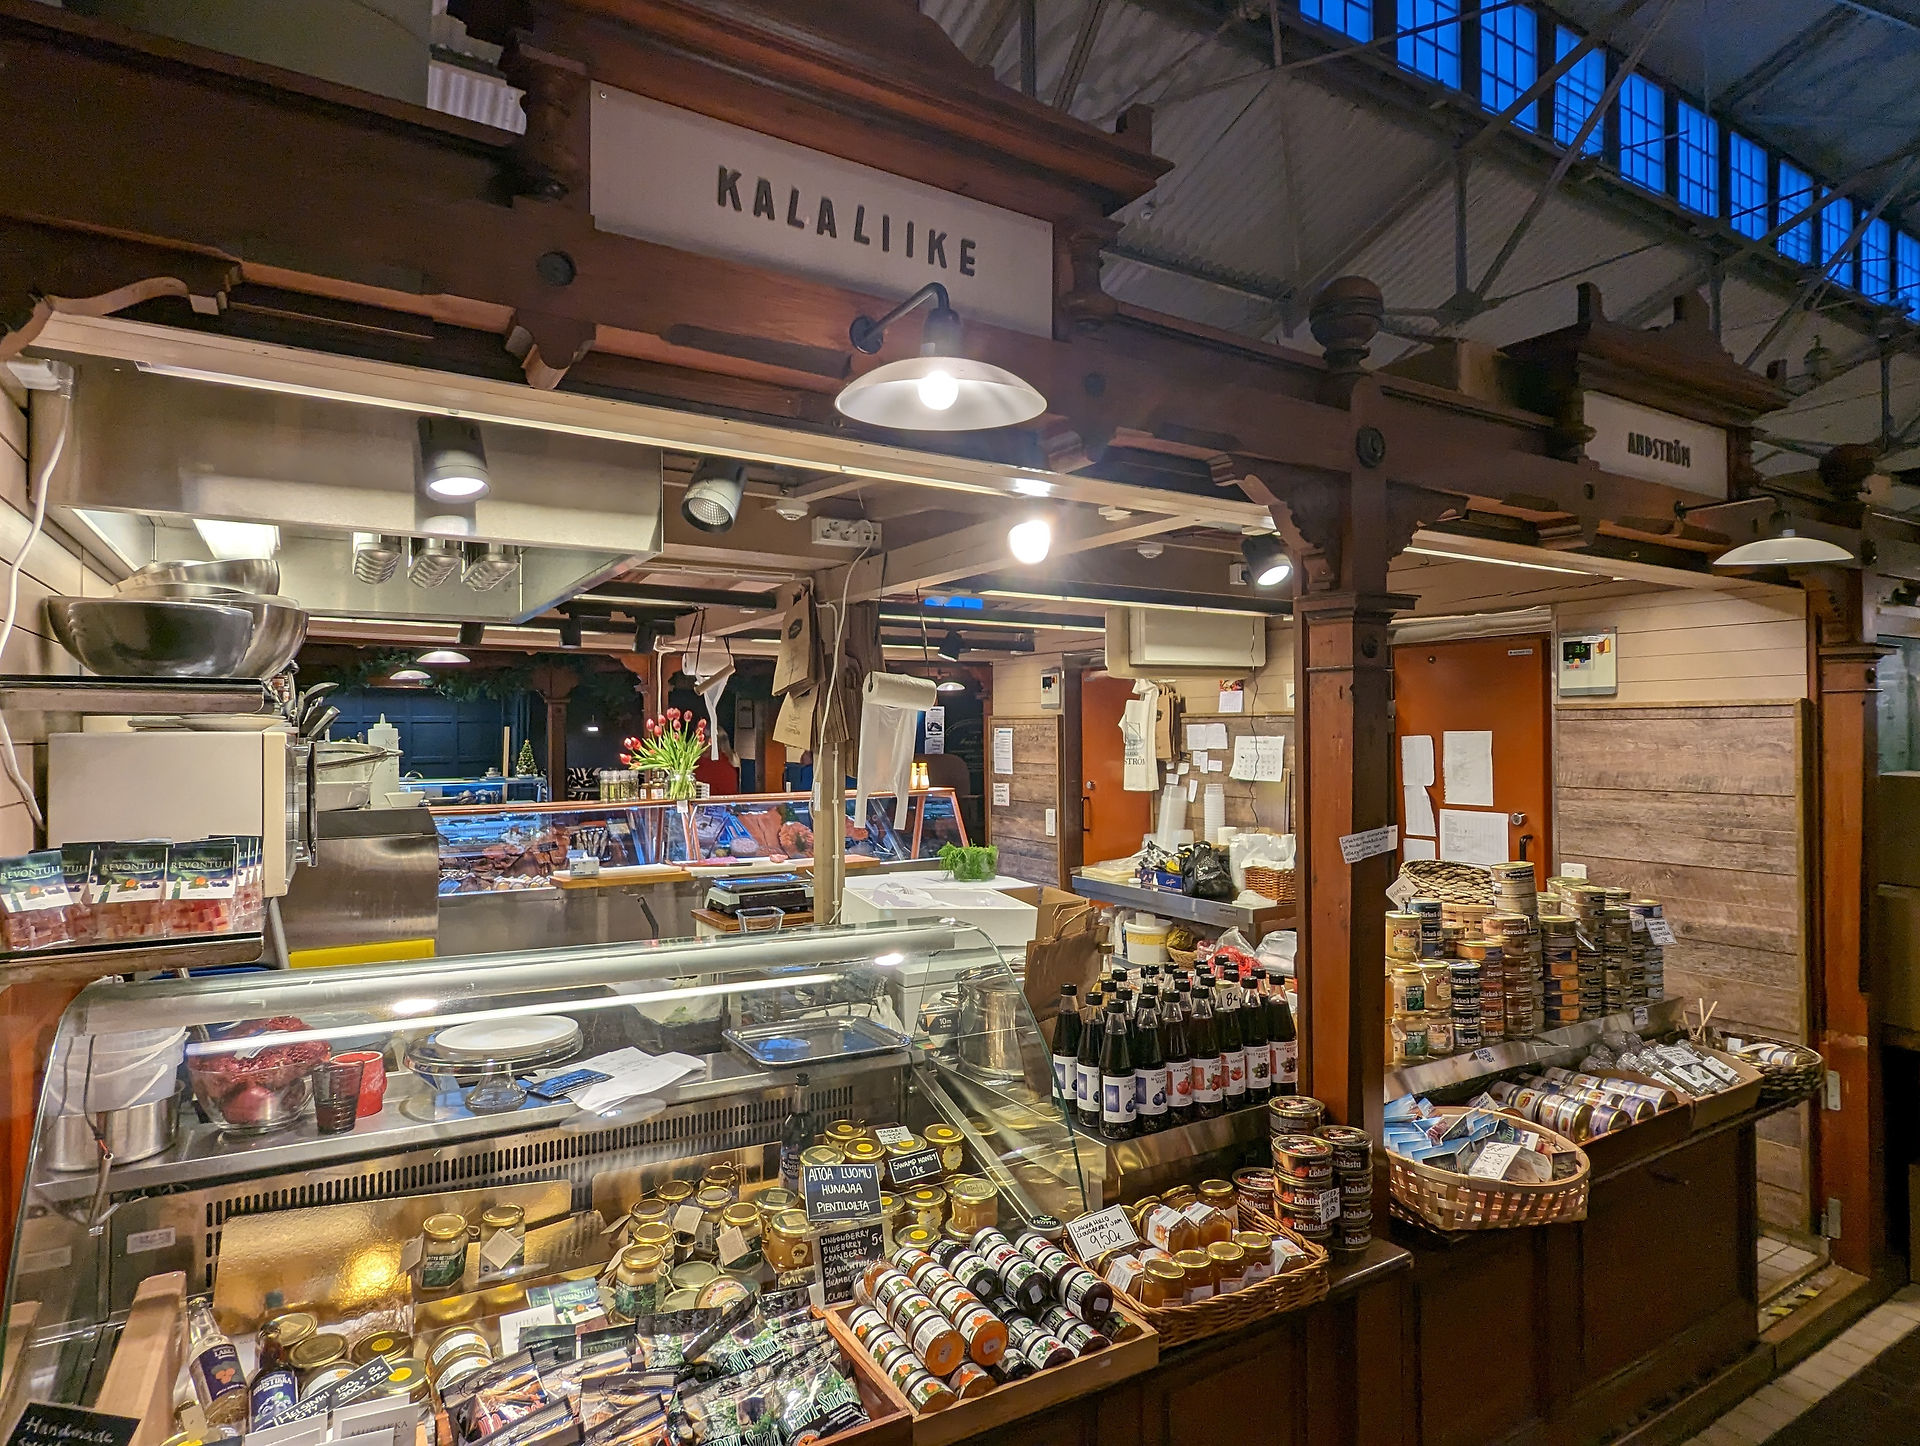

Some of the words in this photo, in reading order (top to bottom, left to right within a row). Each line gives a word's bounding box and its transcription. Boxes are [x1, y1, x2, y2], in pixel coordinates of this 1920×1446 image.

[717, 165, 977, 277] KALALIIKE
[0, 864, 60, 881] REVONTULI
[102, 862, 165, 872] REVONTULI
[808, 1166, 834, 1182] AITOA
[841, 1166, 872, 1179] LUOMU
[909, 1165, 925, 1177] 12€
[821, 1183, 863, 1196] HUNAJAA
[816, 1200, 870, 1213] PIENTILOILTA
[820, 1229, 869, 1246] LINGONBERRY
[823, 1240, 861, 1255] BLUEBERRY
[823, 1246, 868, 1264] CRANBERRY
[278, 1391, 330, 1424] HELSINKI
